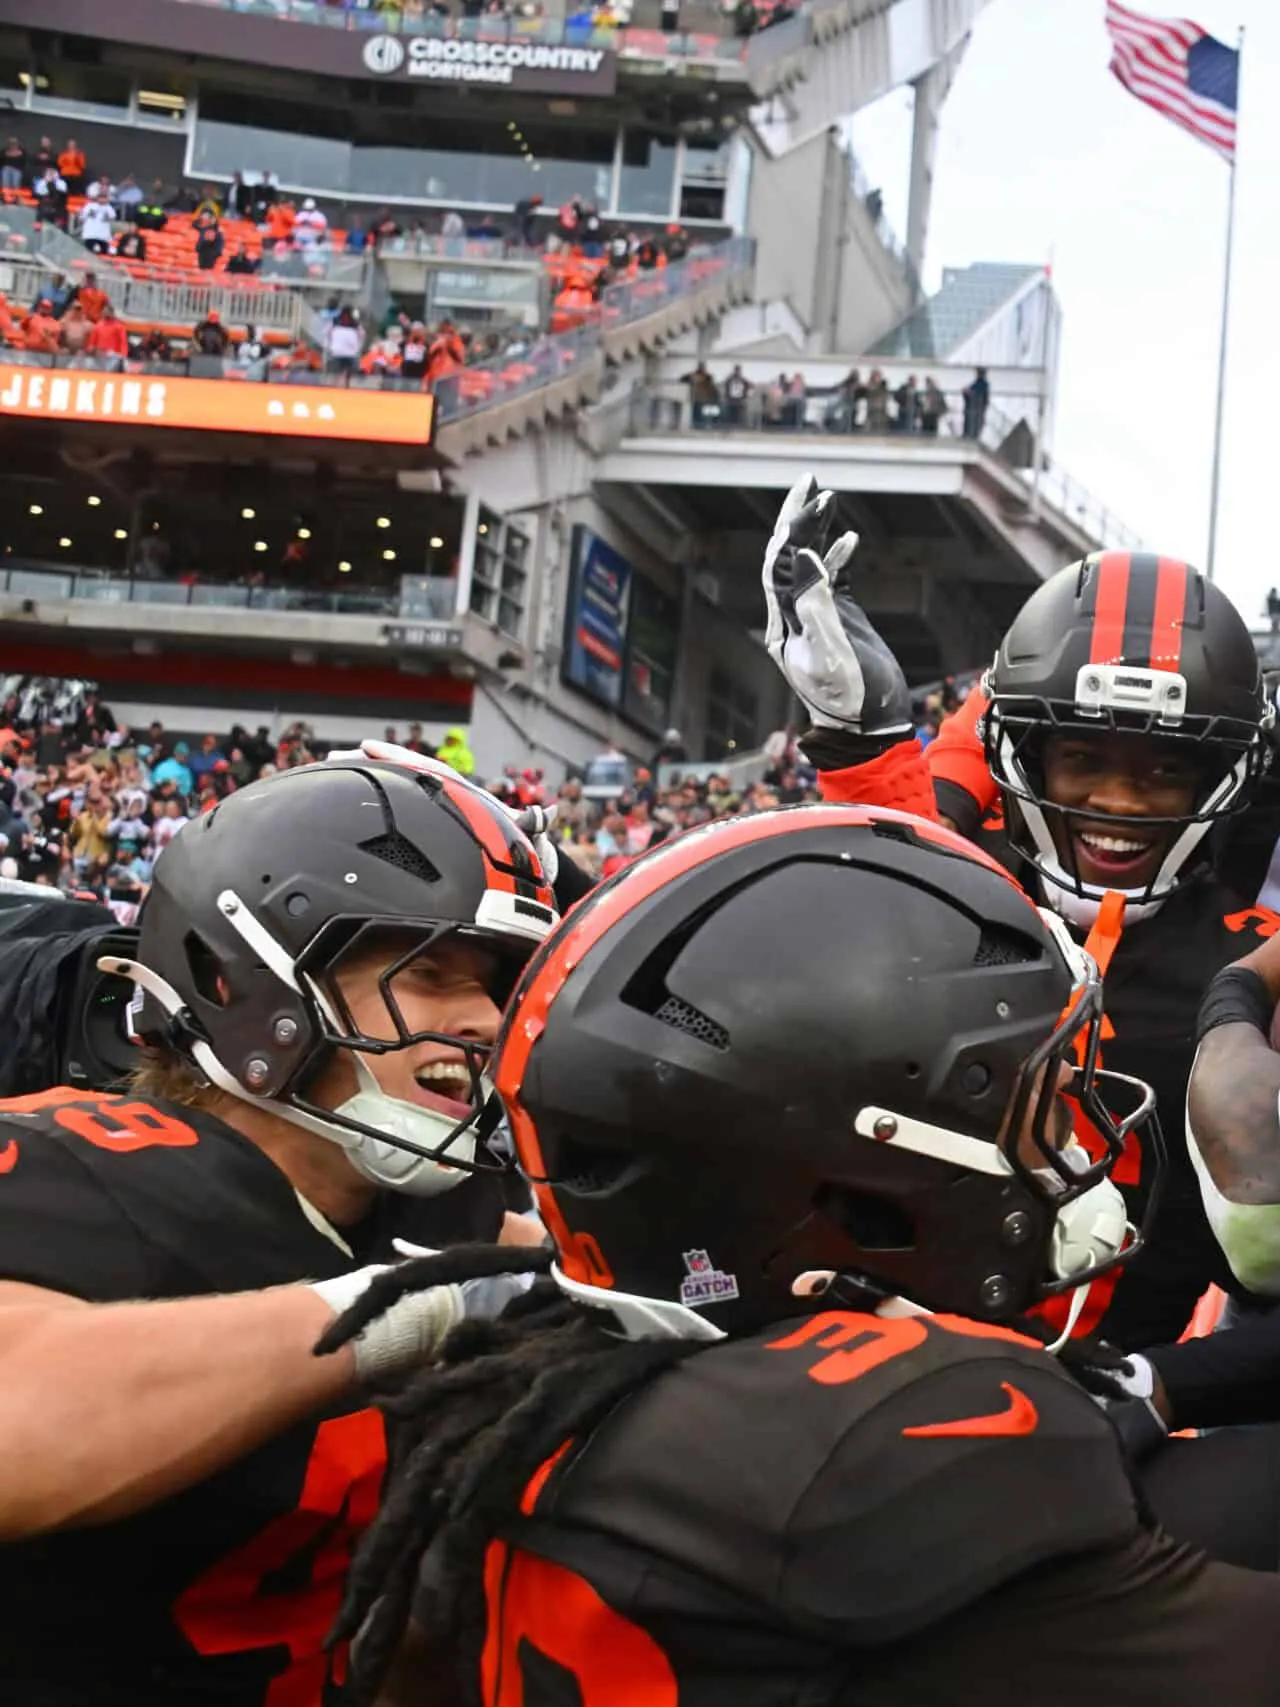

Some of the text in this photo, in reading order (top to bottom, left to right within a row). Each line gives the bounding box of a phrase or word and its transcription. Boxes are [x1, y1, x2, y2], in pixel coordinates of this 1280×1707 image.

[408, 38, 603, 71] CROSSCOUNTRY
[407, 60, 513, 83] MORTGAGE
[2, 373, 168, 417] JENKINS
[683, 1277, 734, 1298] CATCH
